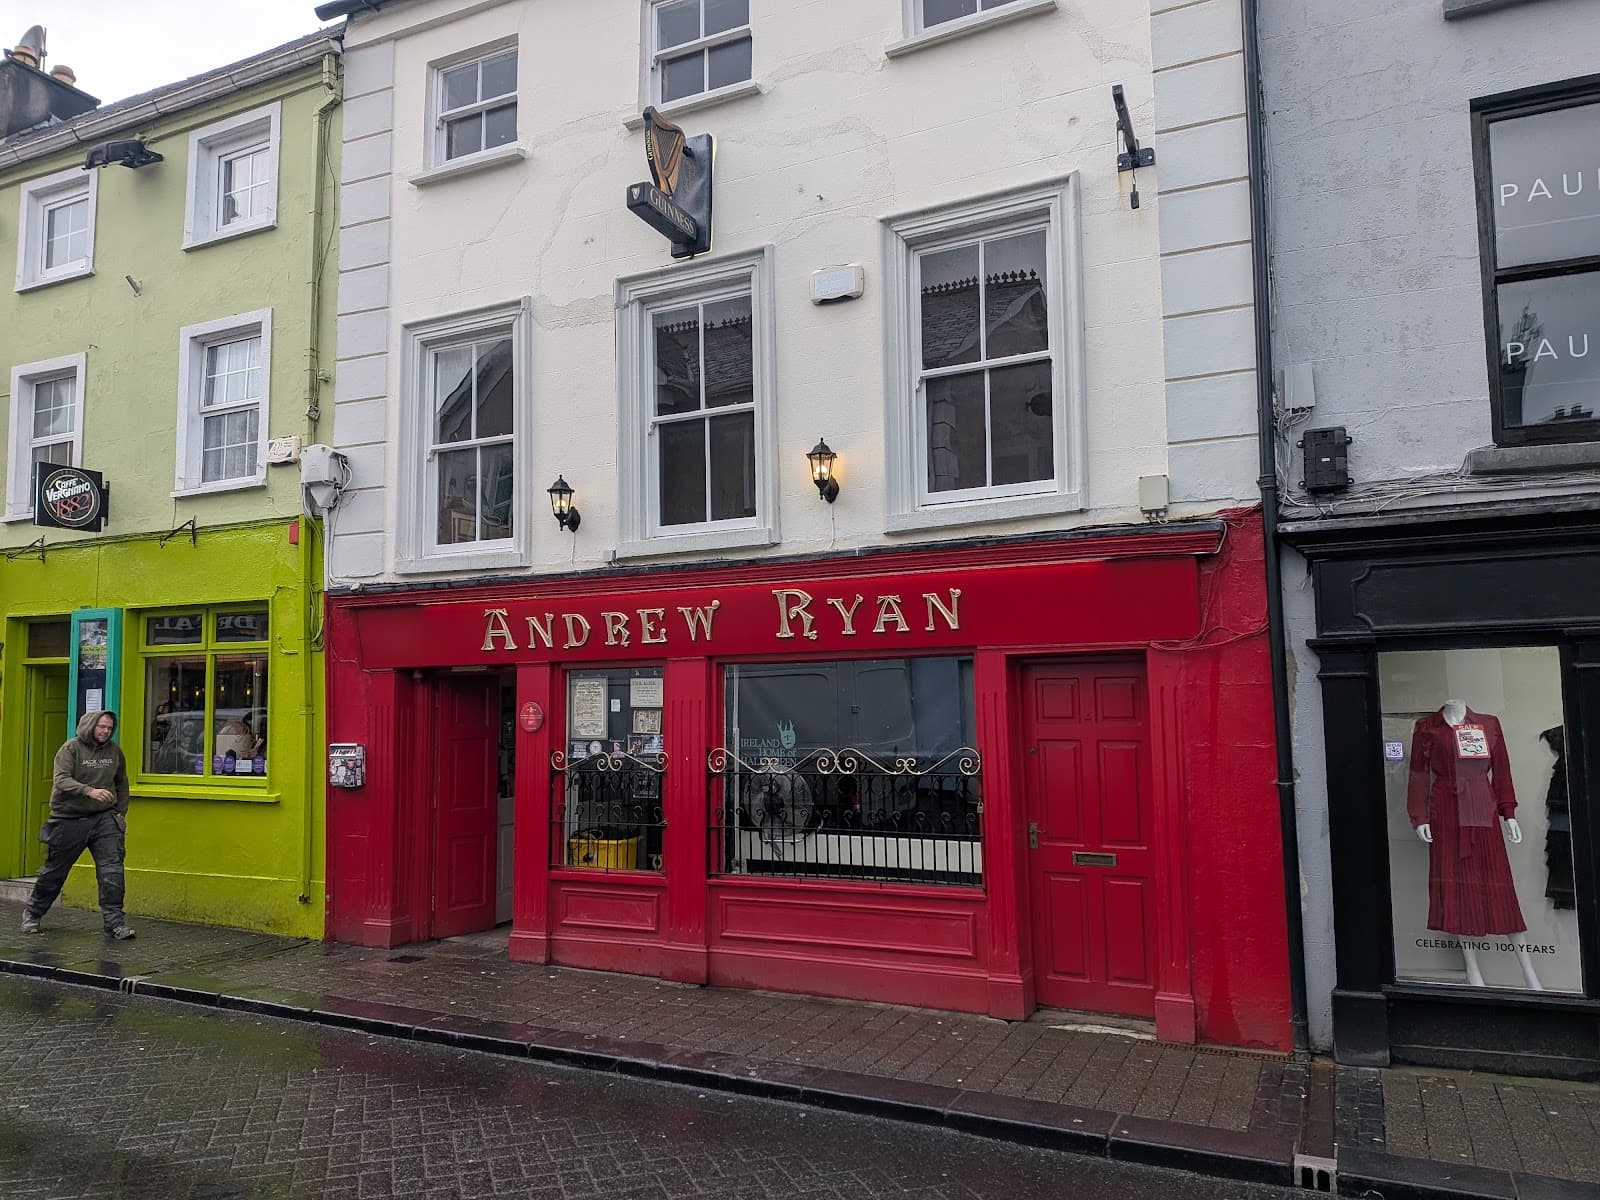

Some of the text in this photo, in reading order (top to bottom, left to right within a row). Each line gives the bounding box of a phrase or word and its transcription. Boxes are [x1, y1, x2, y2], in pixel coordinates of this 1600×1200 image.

[1500, 168, 1600, 207] PAU
[649, 188, 694, 234] GUINNESS
[46, 482, 90, 502] VERGNANO
[56, 493, 90, 517] 1882
[481, 588, 962, 651] ANDREW RYAN
[741, 738, 780, 748] IRELAND
[759, 748, 785, 757] HOME
[1416, 938, 1555, 954] CELEBRATING 100 YEARS
